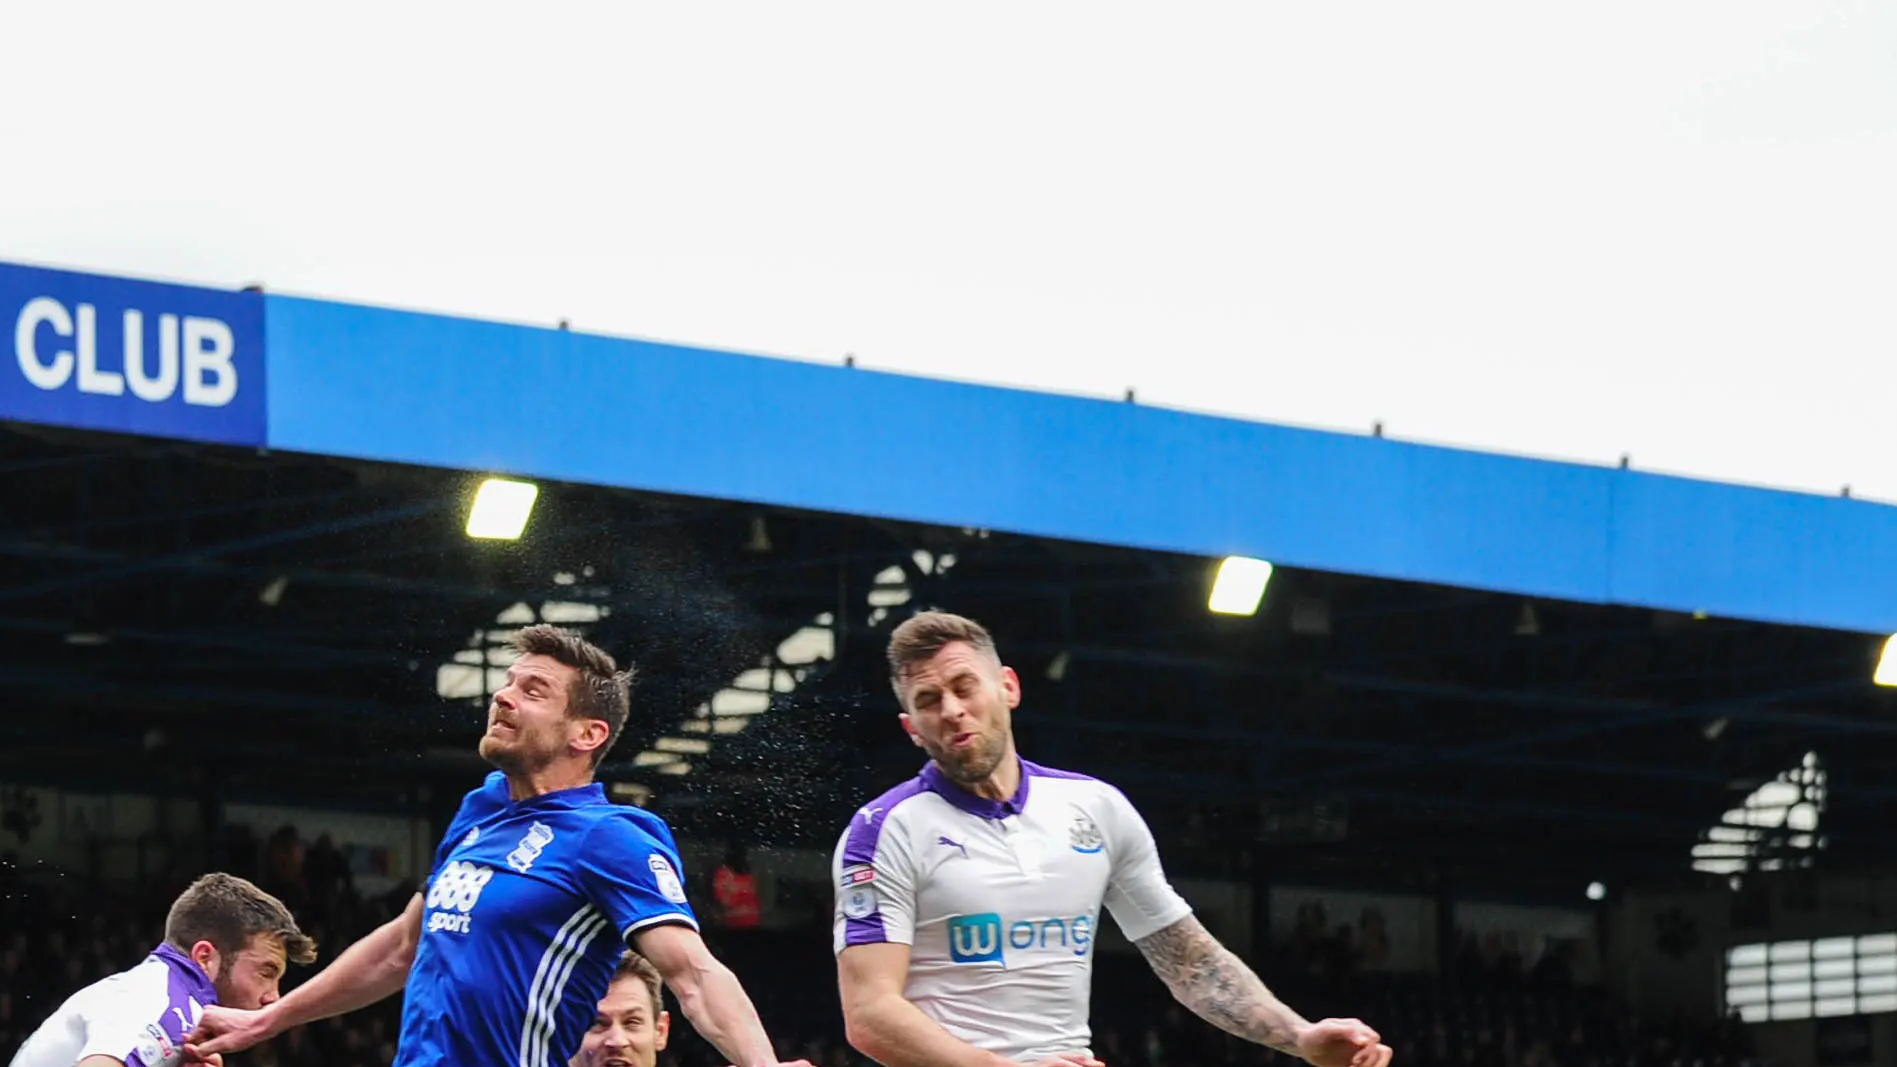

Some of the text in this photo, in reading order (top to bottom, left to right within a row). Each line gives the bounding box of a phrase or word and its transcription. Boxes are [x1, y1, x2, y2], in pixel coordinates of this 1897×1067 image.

[14, 297, 238, 407] CLUB
[427, 860, 494, 912] 888
[428, 911, 471, 933] sport
[954, 915, 1092, 956] wong
